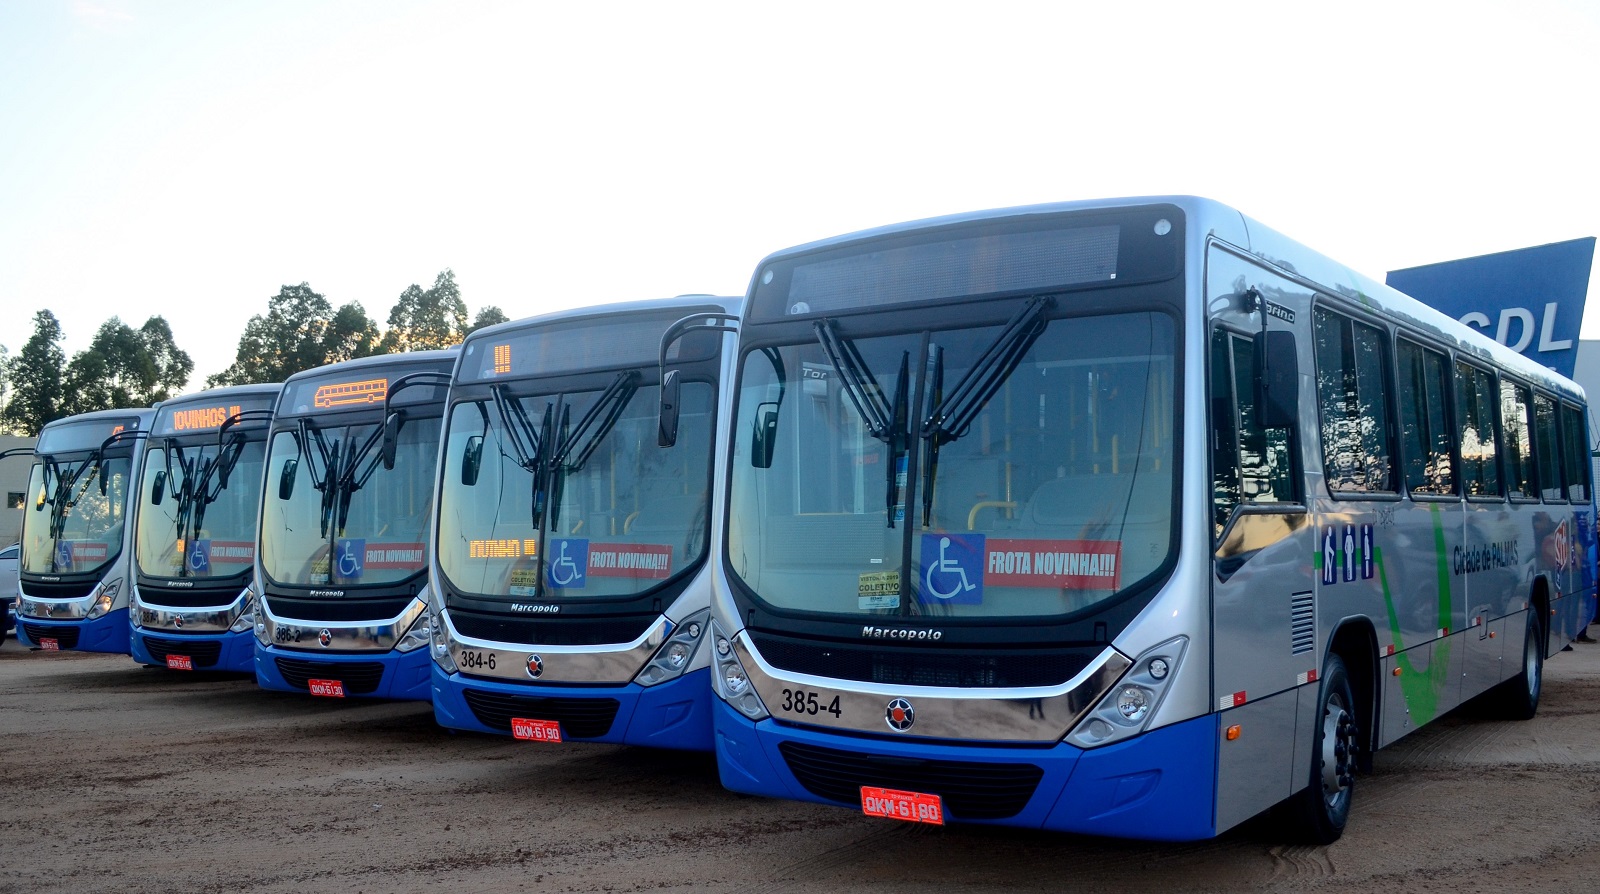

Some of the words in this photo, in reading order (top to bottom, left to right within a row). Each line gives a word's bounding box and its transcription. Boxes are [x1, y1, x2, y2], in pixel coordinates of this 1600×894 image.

[1265, 303, 1295, 322] orino
[366, 550, 385, 563] FROTA
[590, 551, 616, 568] FROTA
[617, 552, 669, 570] NOVINHA!!!
[988, 551, 1032, 575] FROTA
[1033, 552, 1116, 577] NOVINHA!!!
[1453, 545, 1480, 576] Cidade
[1482, 543, 1491, 571] de
[1492, 539, 1519, 569] PALMAS
[309, 589, 344, 597] Marcopolo
[859, 583, 900, 592] COLETIVO
[510, 603, 559, 613] Marcopolo
[276, 627, 301, 643] 386-2
[862, 626, 942, 640] Marcopolo
[461, 650, 496, 670] 384-6
[782, 688, 842, 719] 385-4
